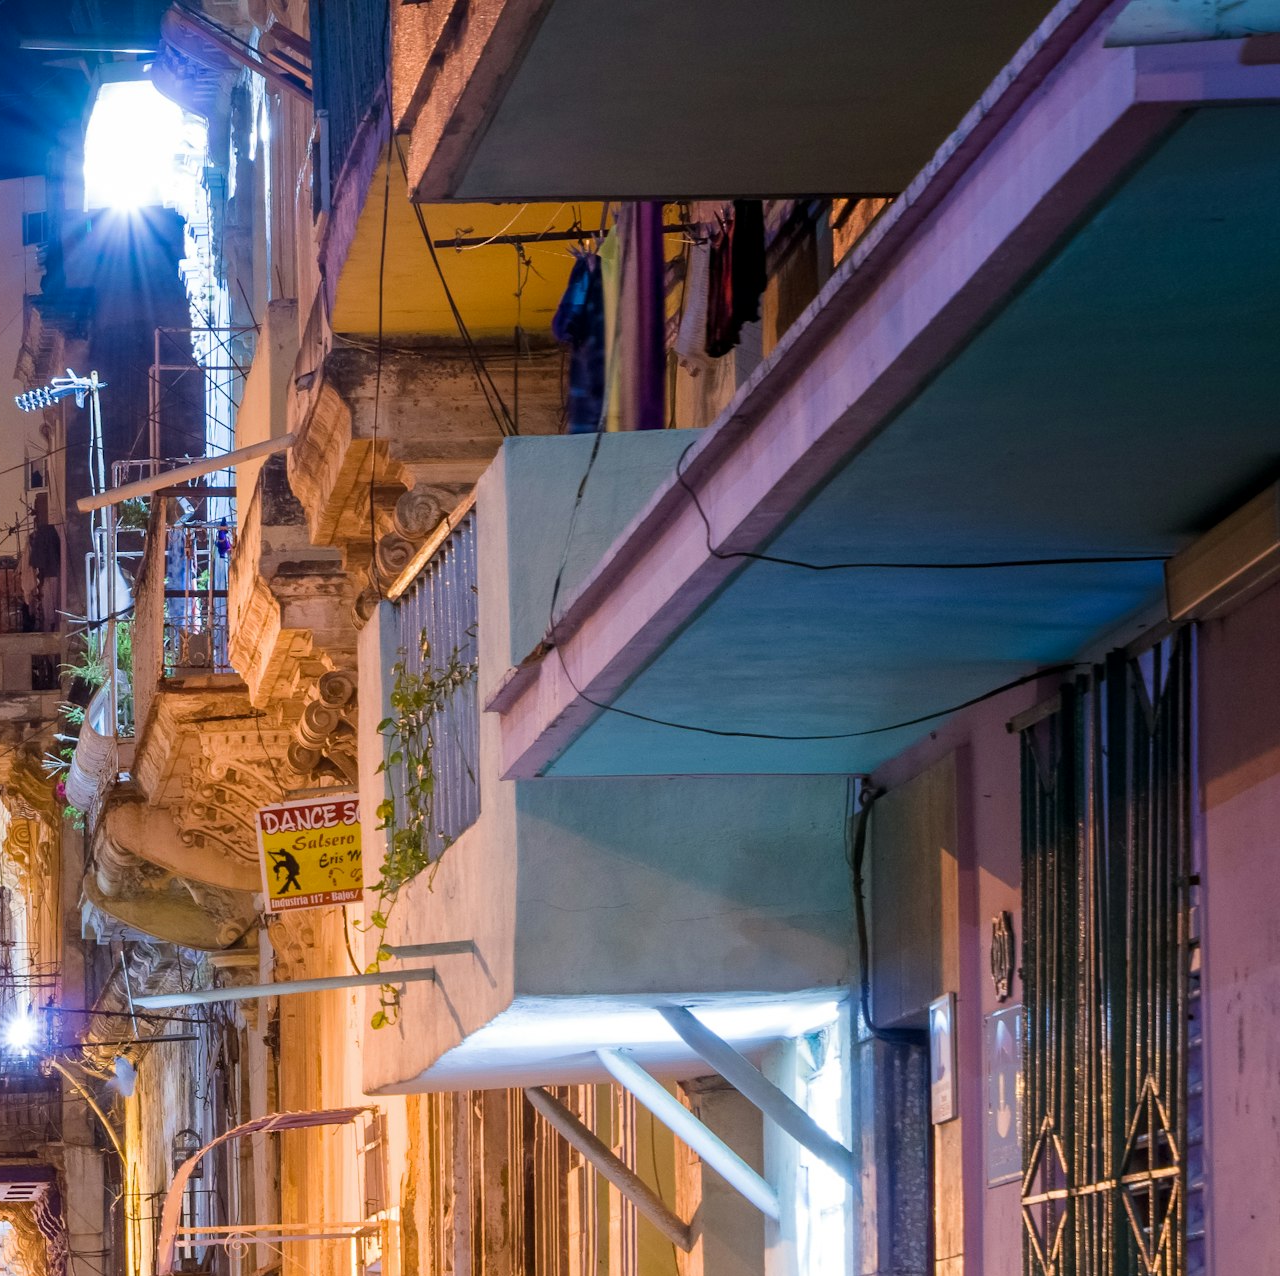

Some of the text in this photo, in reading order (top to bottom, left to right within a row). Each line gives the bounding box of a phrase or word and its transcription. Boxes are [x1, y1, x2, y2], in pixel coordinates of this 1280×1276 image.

[263, 804, 339, 835] DANCE
[292, 833, 354, 850] Salsero
[319, 852, 343, 868] Eris
[271, 896, 308, 908] Industria
[310, 893, 323, 904] 117
